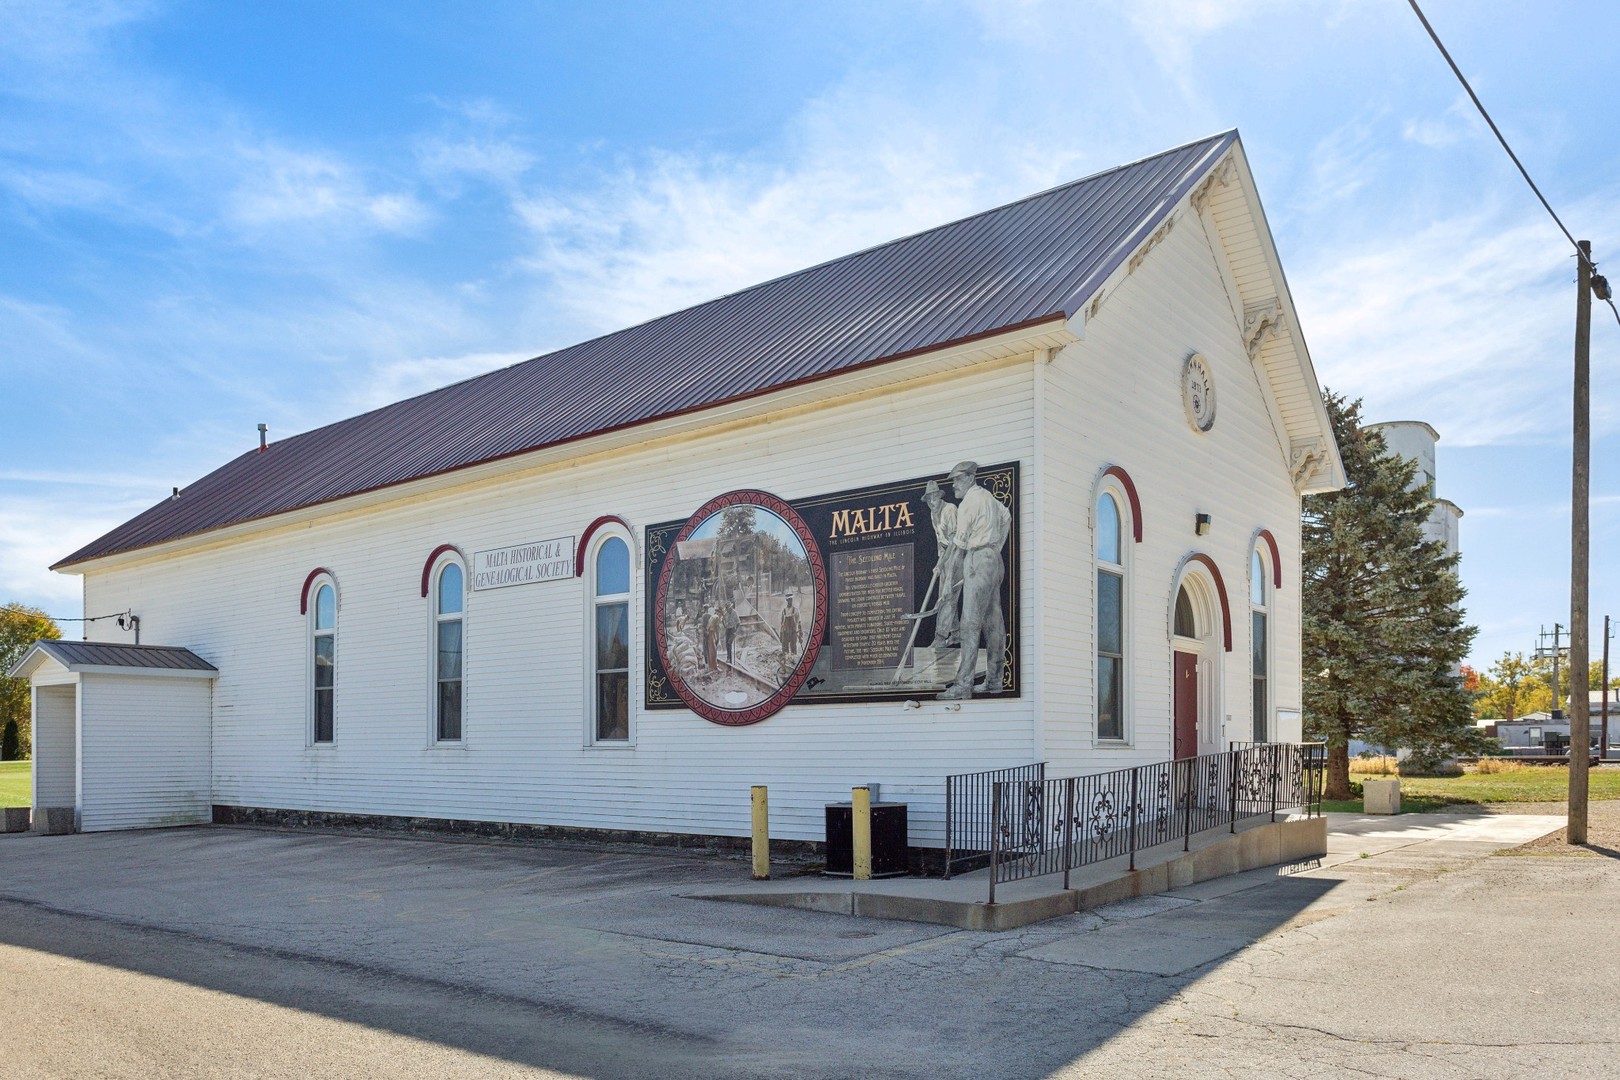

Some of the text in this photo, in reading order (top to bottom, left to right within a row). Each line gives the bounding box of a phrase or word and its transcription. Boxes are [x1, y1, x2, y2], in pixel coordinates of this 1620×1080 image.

[829, 501, 915, 539] MALTA
[840, 537, 859, 545] LINCOLN
[861, 533, 883, 541] HIGHWAY
[893, 528, 915, 537] ILLINOIS
[485, 542, 561, 569] MALTA HISTORICAL &
[475, 559, 572, 588] GENEALOGICAL SOCIETY
